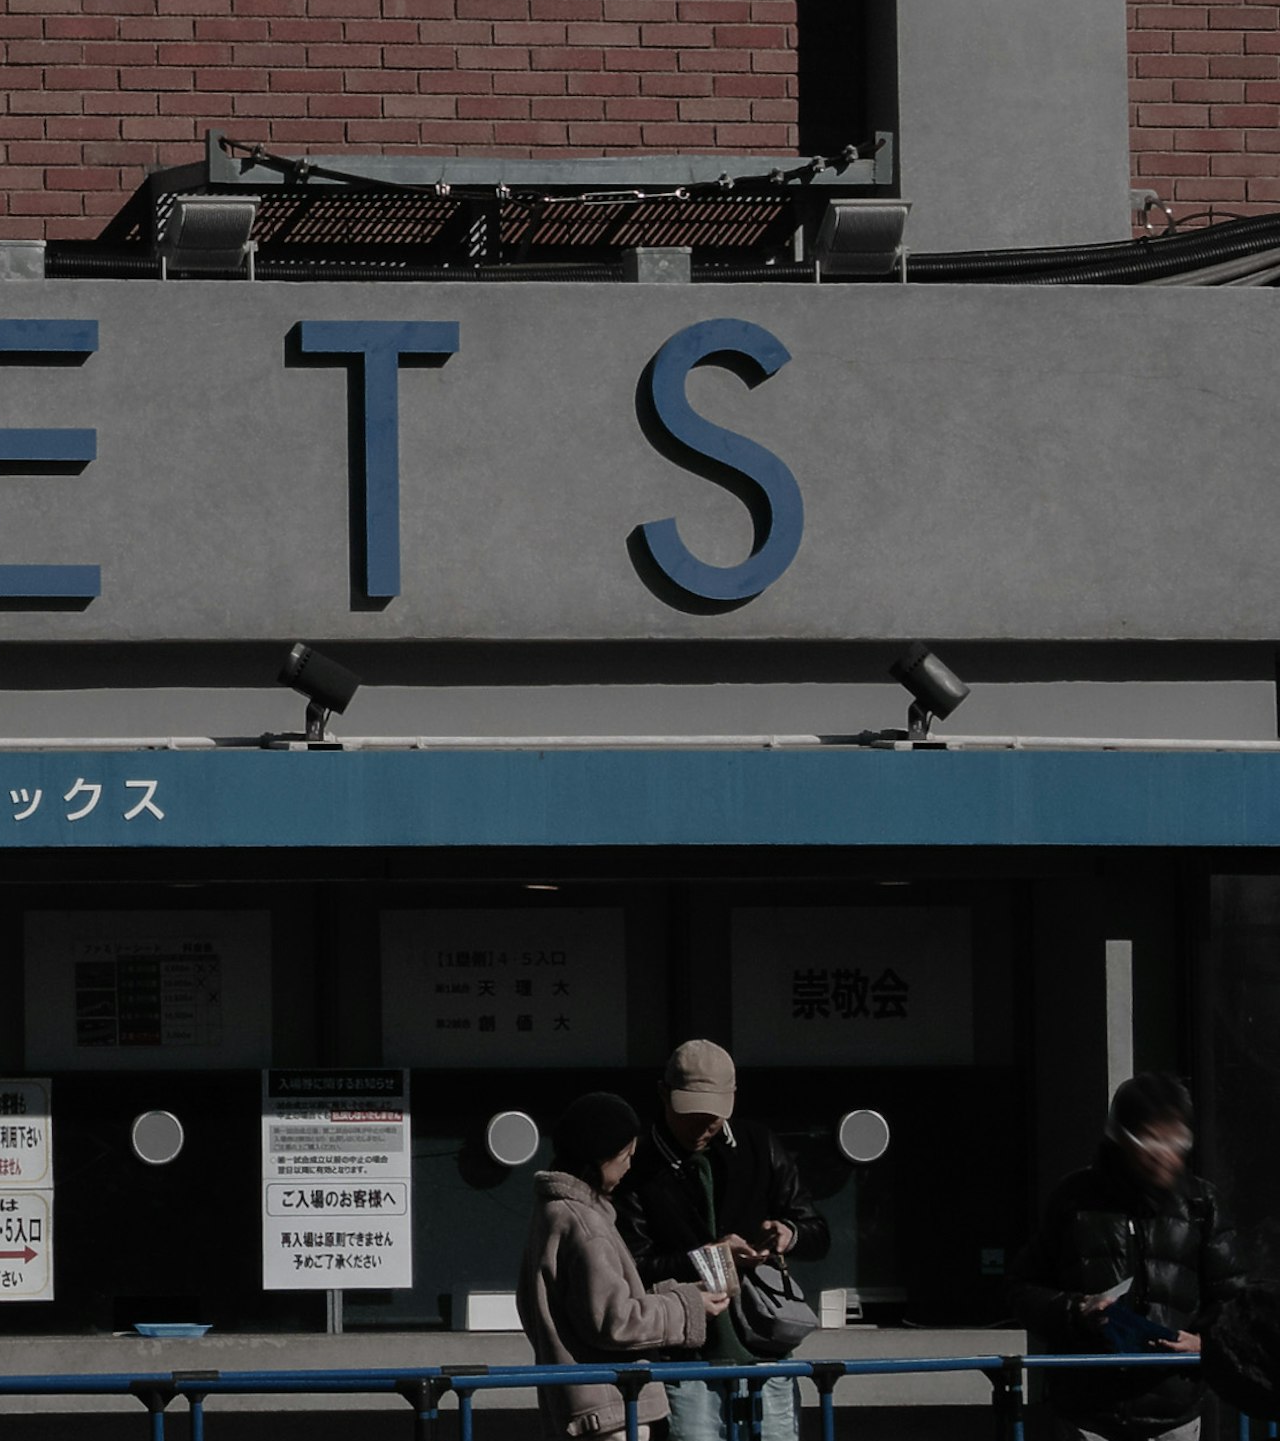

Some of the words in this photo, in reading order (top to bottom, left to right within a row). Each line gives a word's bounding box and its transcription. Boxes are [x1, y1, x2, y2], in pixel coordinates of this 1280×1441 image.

[792, 967, 909, 1019] 崇敬会
[282, 1189, 396, 1209] ご入場のお客様へ
